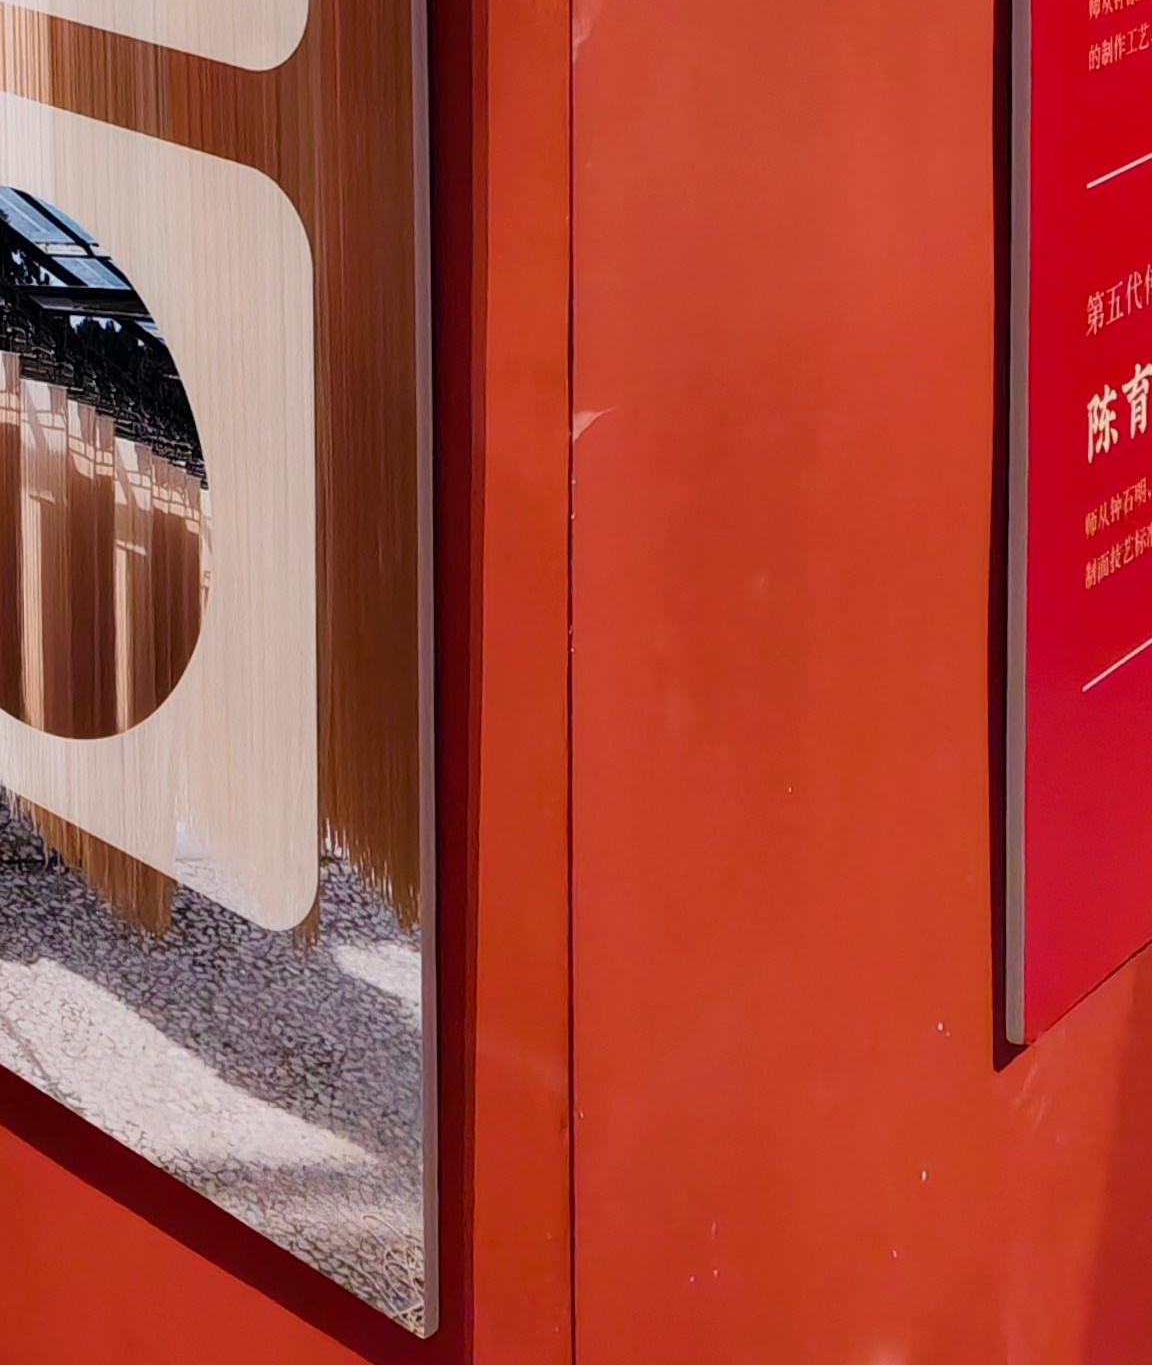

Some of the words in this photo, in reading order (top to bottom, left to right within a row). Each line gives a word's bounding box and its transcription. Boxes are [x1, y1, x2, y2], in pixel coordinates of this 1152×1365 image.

[1088, 22, 1152, 71] 的制作工艺
[1086, 362, 1152, 465] 陈育
